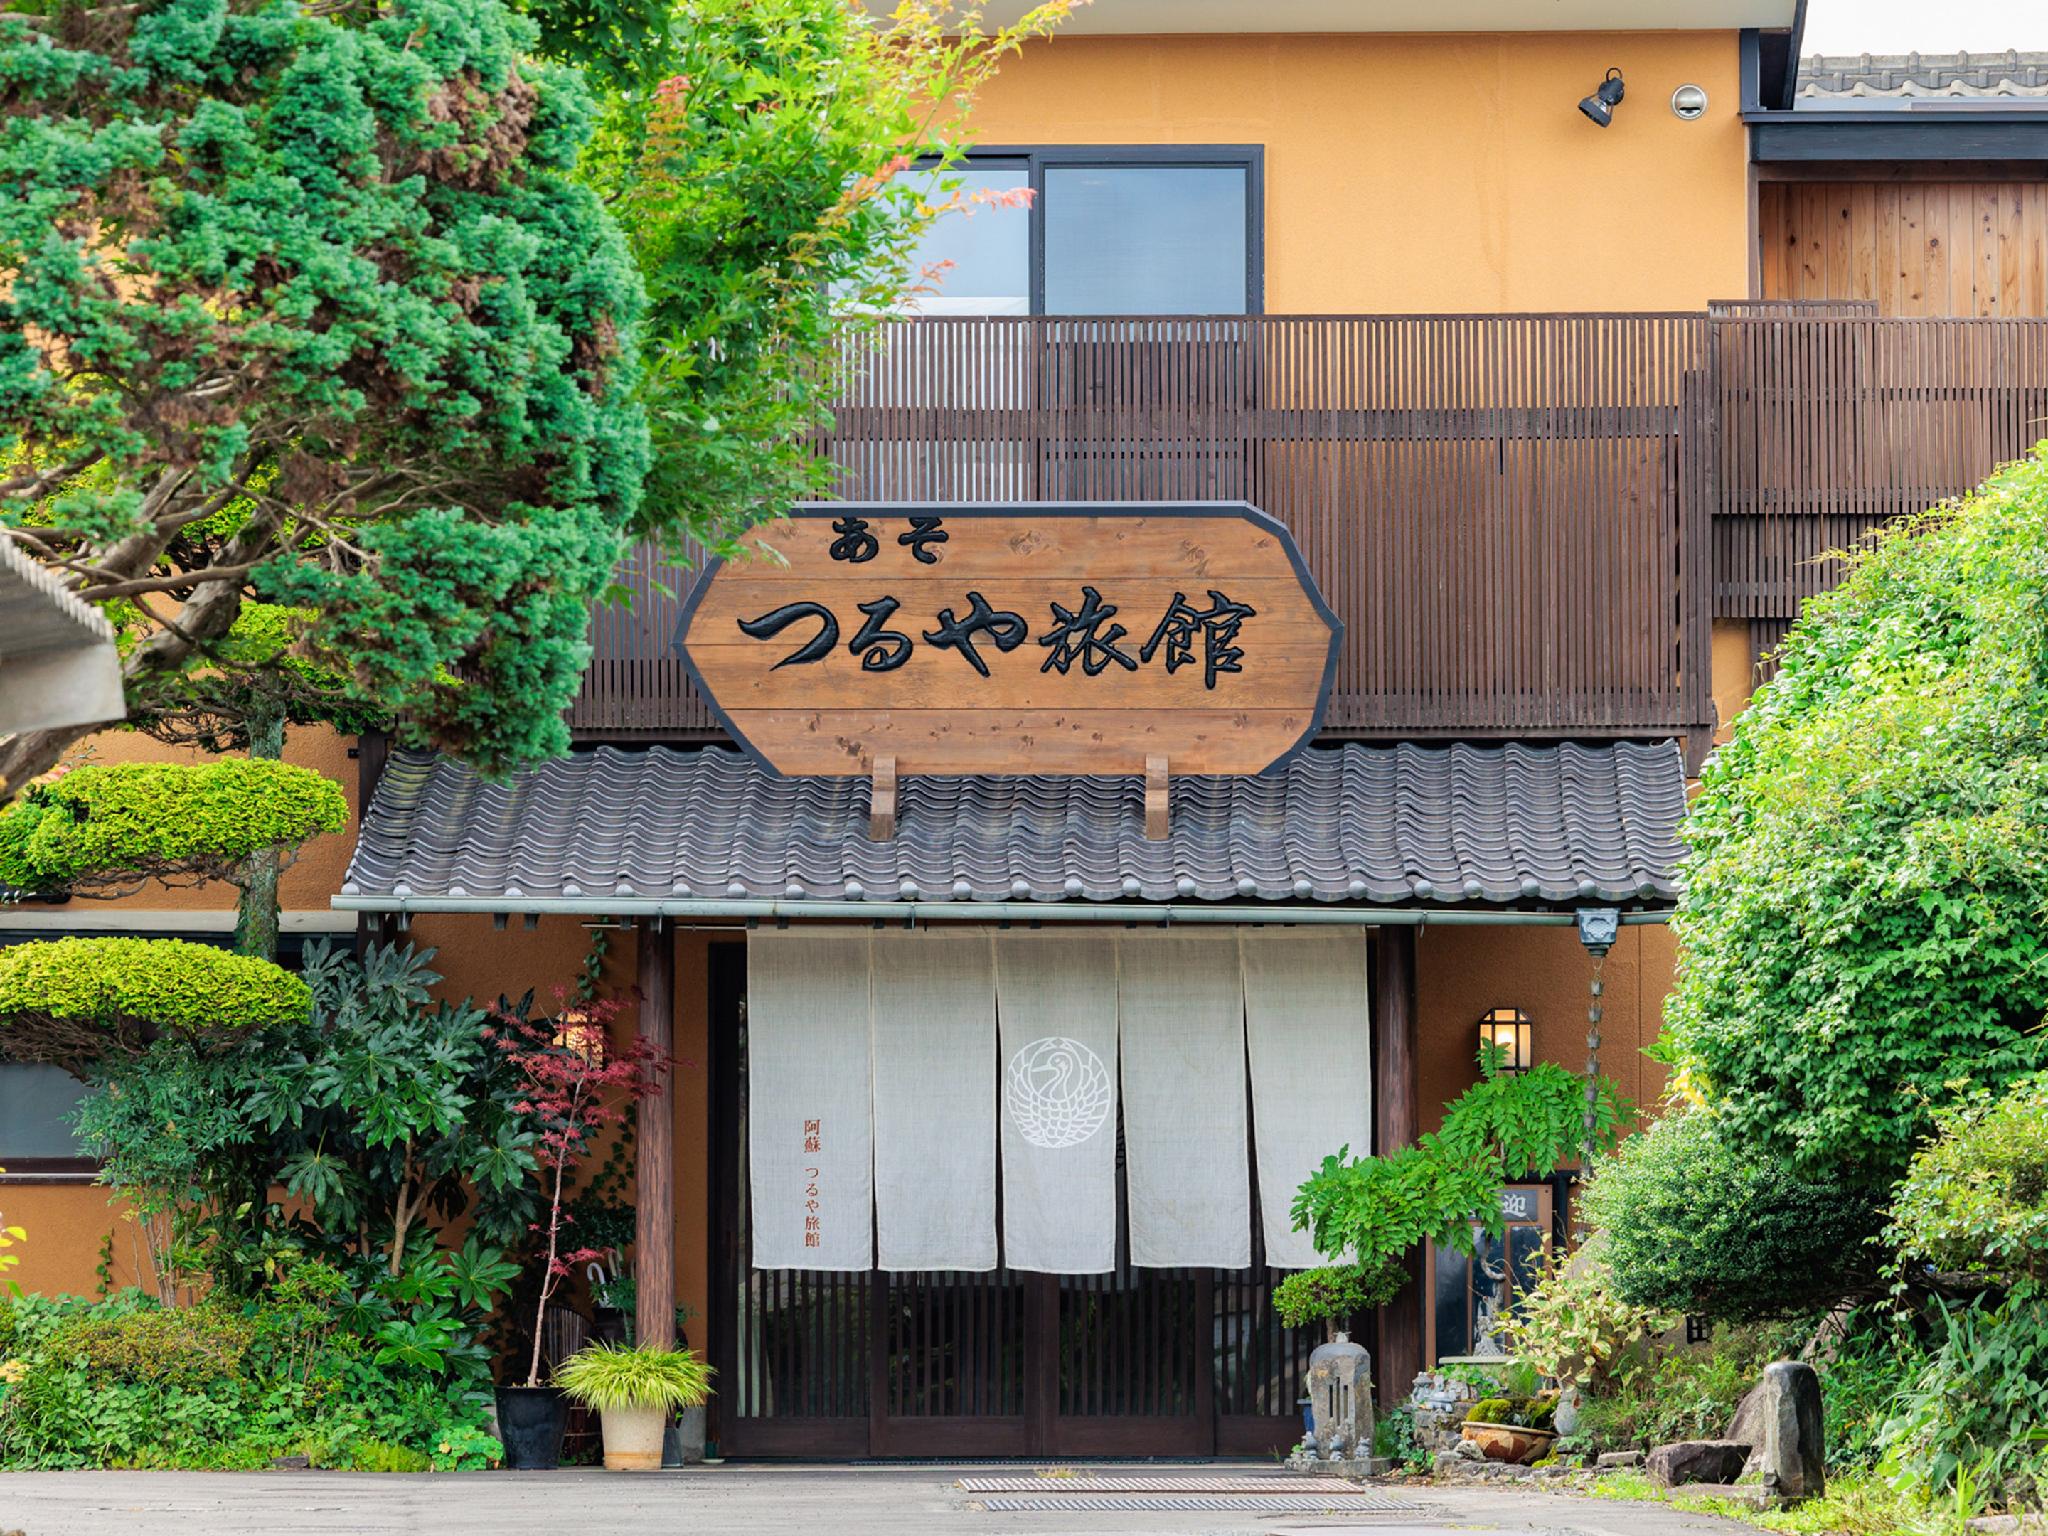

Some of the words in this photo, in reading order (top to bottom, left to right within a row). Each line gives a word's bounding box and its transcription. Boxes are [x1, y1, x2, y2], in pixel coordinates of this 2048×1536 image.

[736, 586, 1256, 690] つるや旅館
[804, 1119, 821, 1153] 阿蘇
[804, 1167, 821, 1247] つるや旅館
